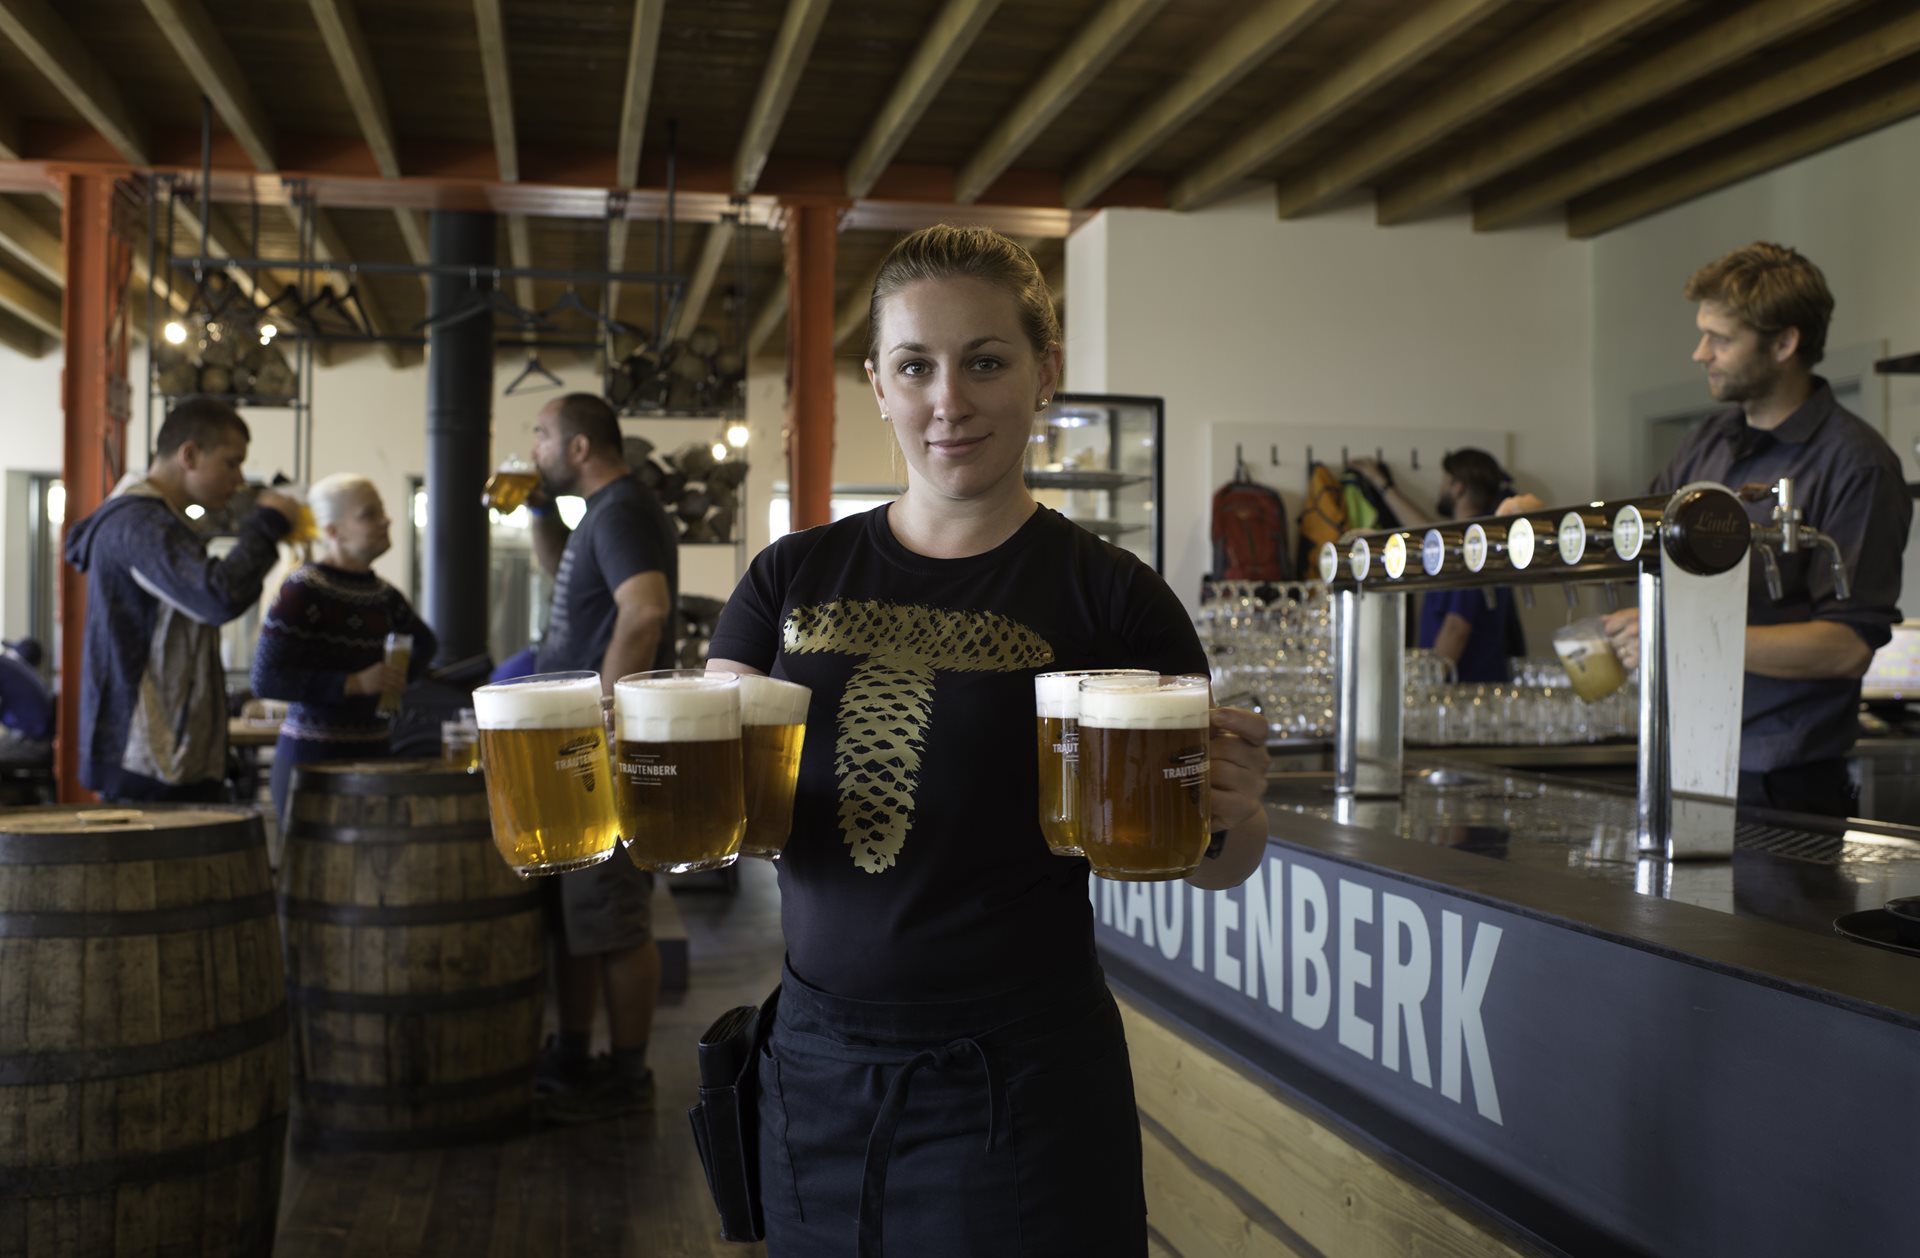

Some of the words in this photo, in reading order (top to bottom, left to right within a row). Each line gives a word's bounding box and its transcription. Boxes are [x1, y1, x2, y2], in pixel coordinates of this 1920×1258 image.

[1053, 743, 1079, 753] TRAUT
[619, 763, 677, 775] TRAUTENBERK
[1089, 858, 1503, 1126] AUTENBERK
